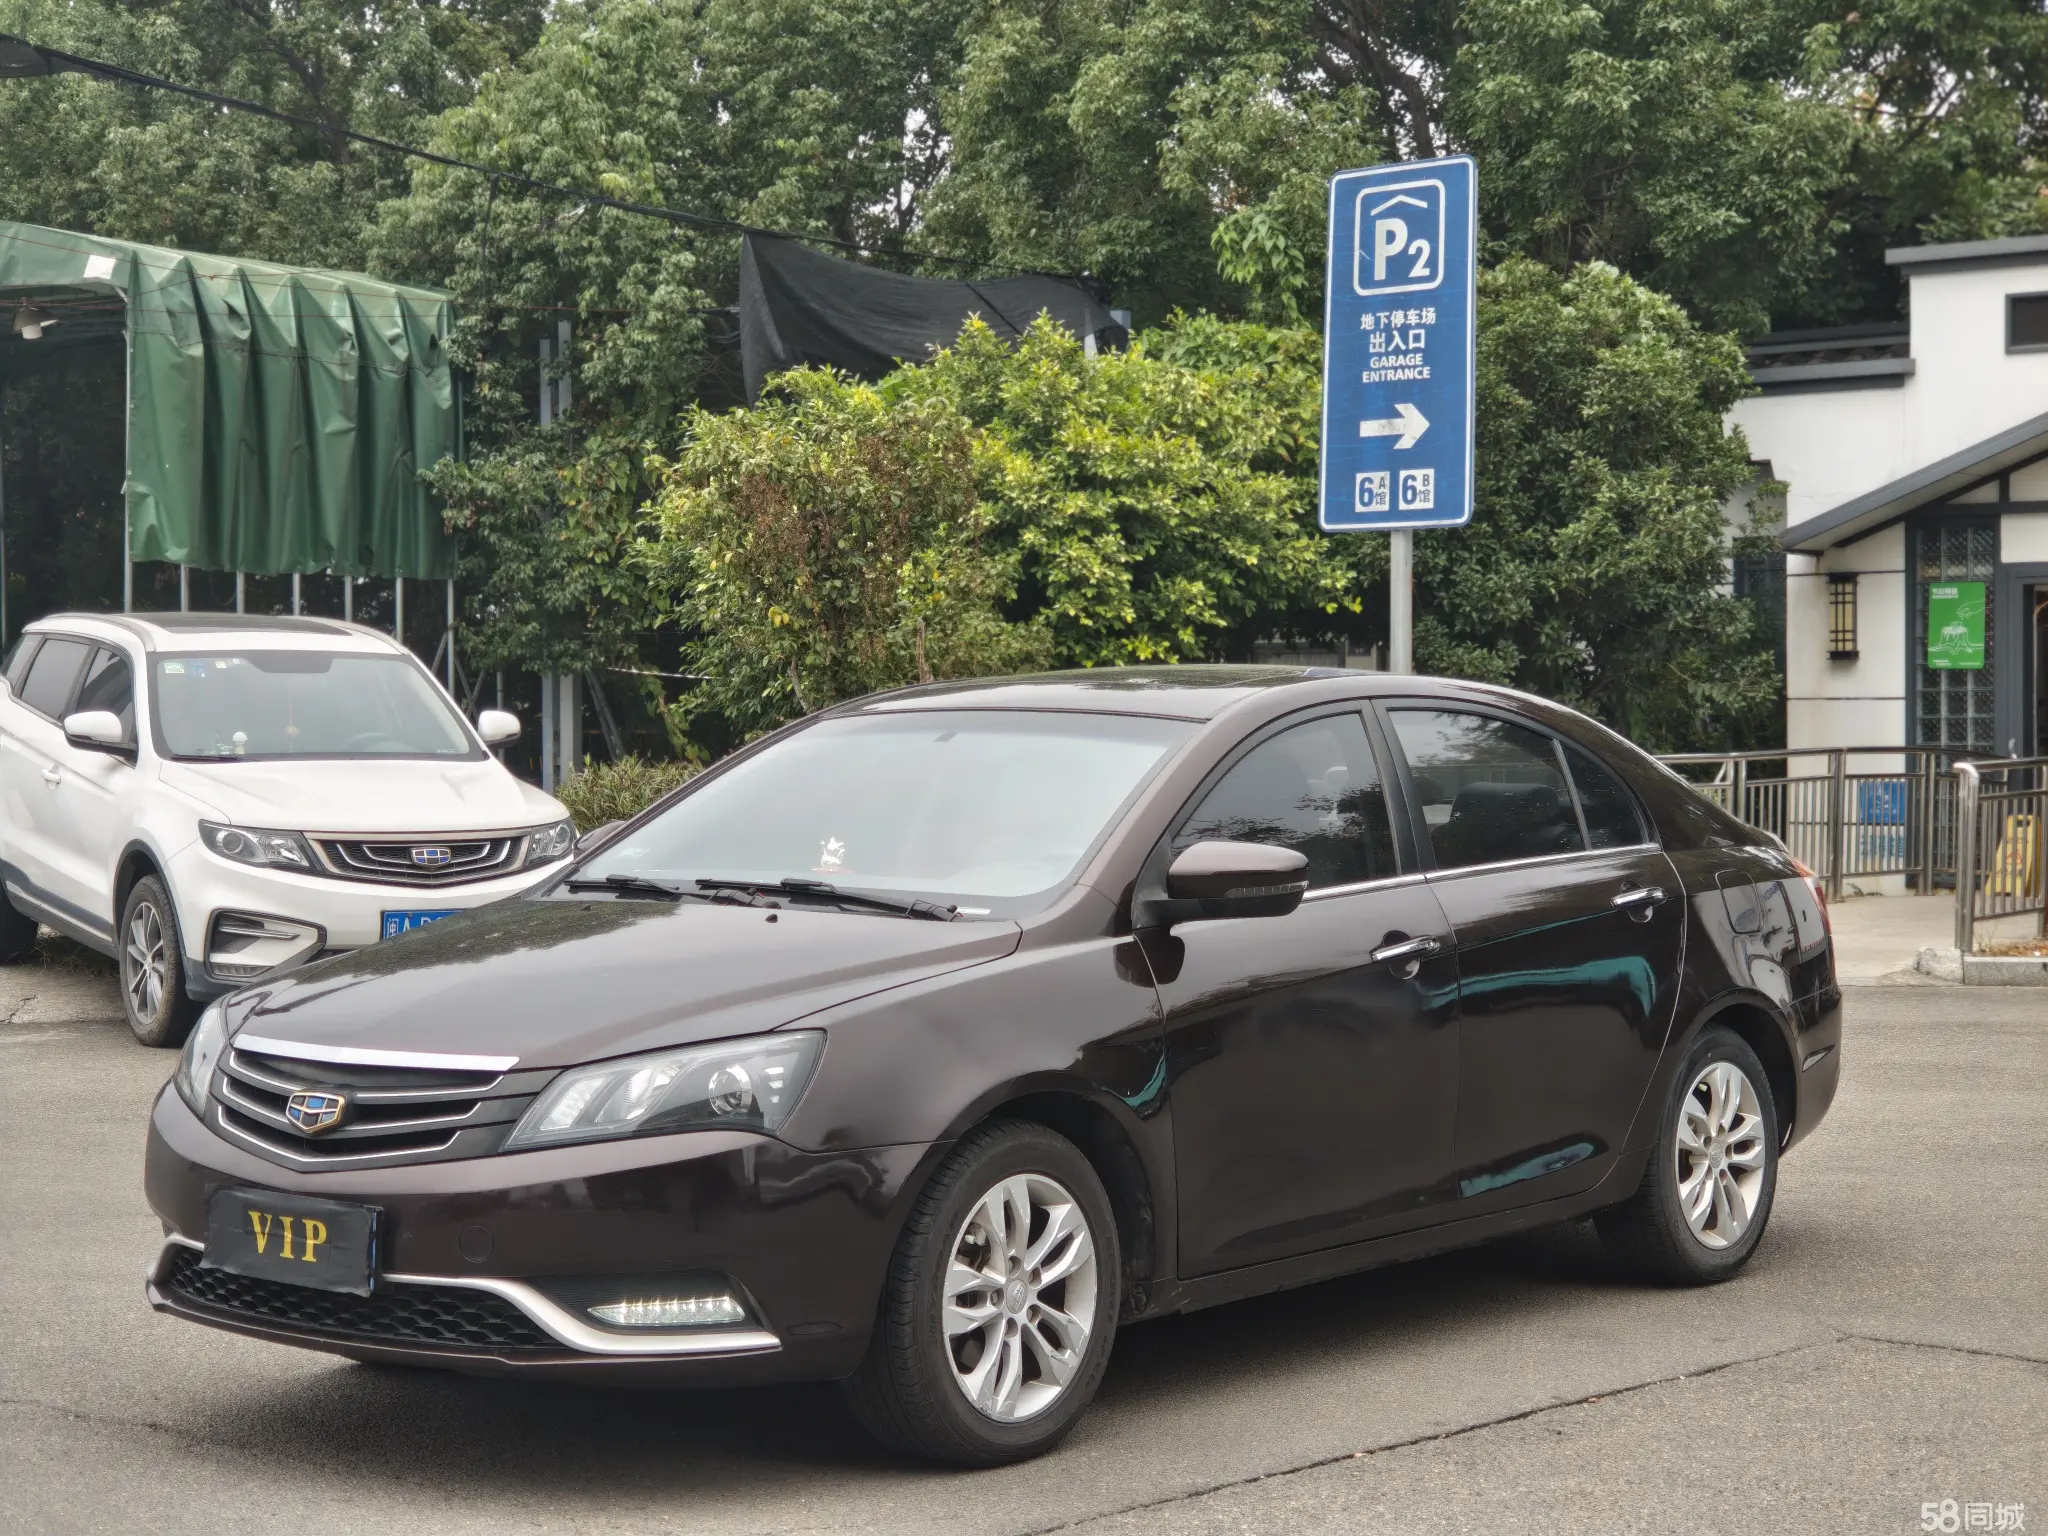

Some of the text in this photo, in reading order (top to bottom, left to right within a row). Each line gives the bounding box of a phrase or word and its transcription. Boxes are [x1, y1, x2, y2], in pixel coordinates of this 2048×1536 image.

[1374, 217, 1431, 281] P2
[1360, 307, 1436, 330] 地下停车场
[1369, 329, 1426, 353] 出入口
[1370, 353, 1424, 369] GARAGE
[1362, 366, 1431, 383] ENTRANCE
[248, 1210, 328, 1263] VIP
